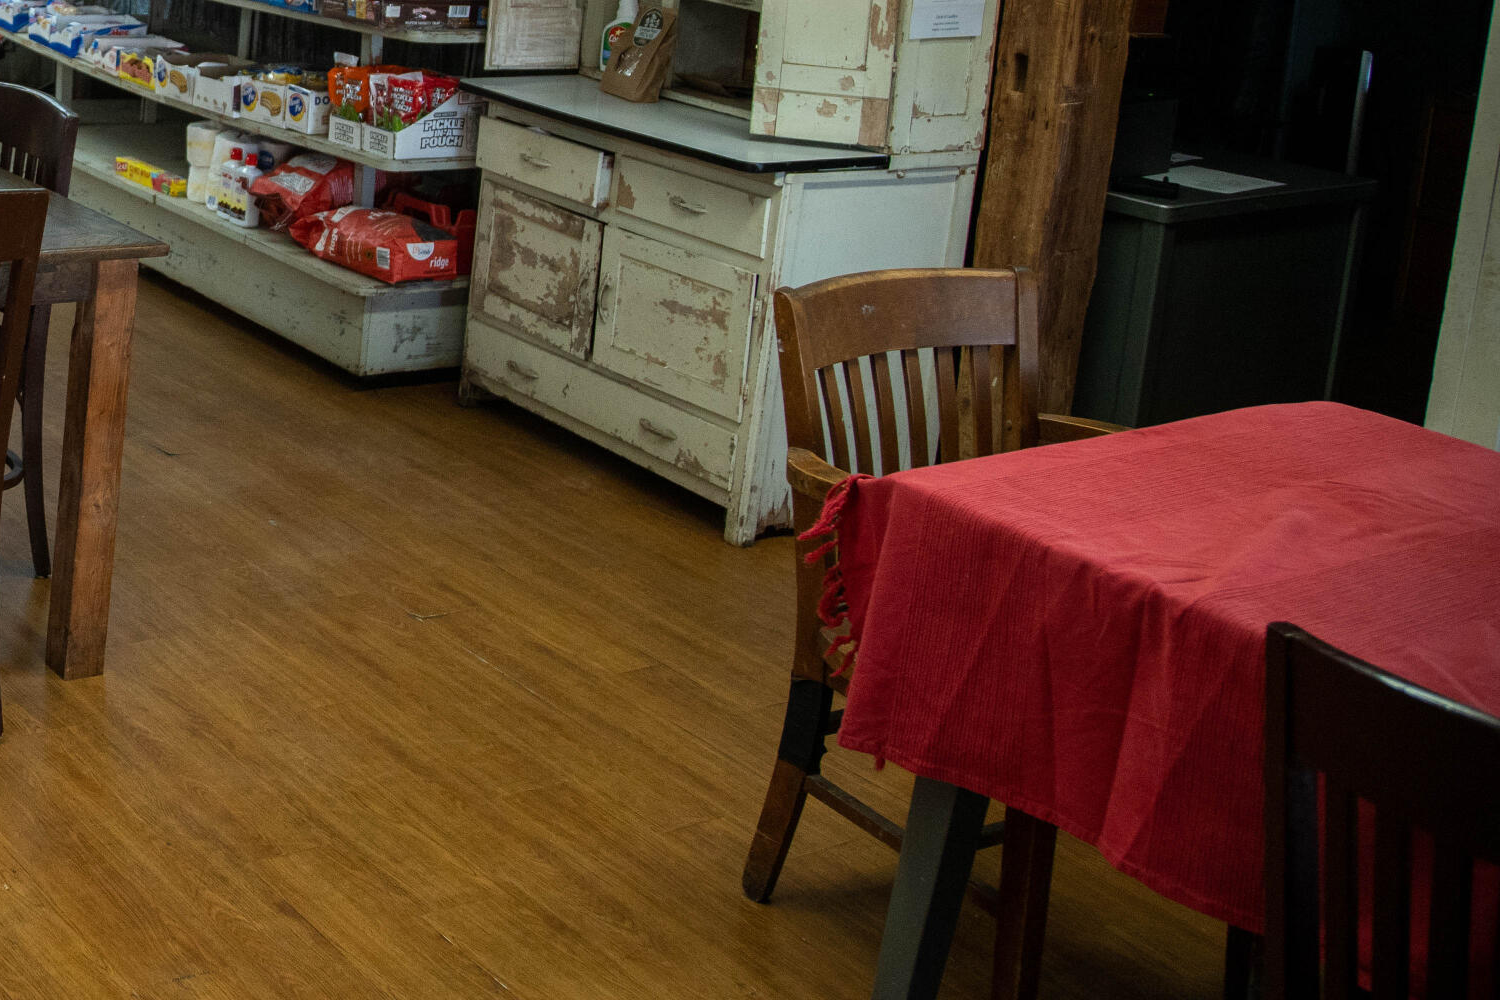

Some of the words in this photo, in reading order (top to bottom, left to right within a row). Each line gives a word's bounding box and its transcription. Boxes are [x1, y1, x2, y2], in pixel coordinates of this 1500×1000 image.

[423, 118, 465, 132] PICKLE
[420, 135, 465, 149] POUCH
[429, 256, 449, 269] ridge
